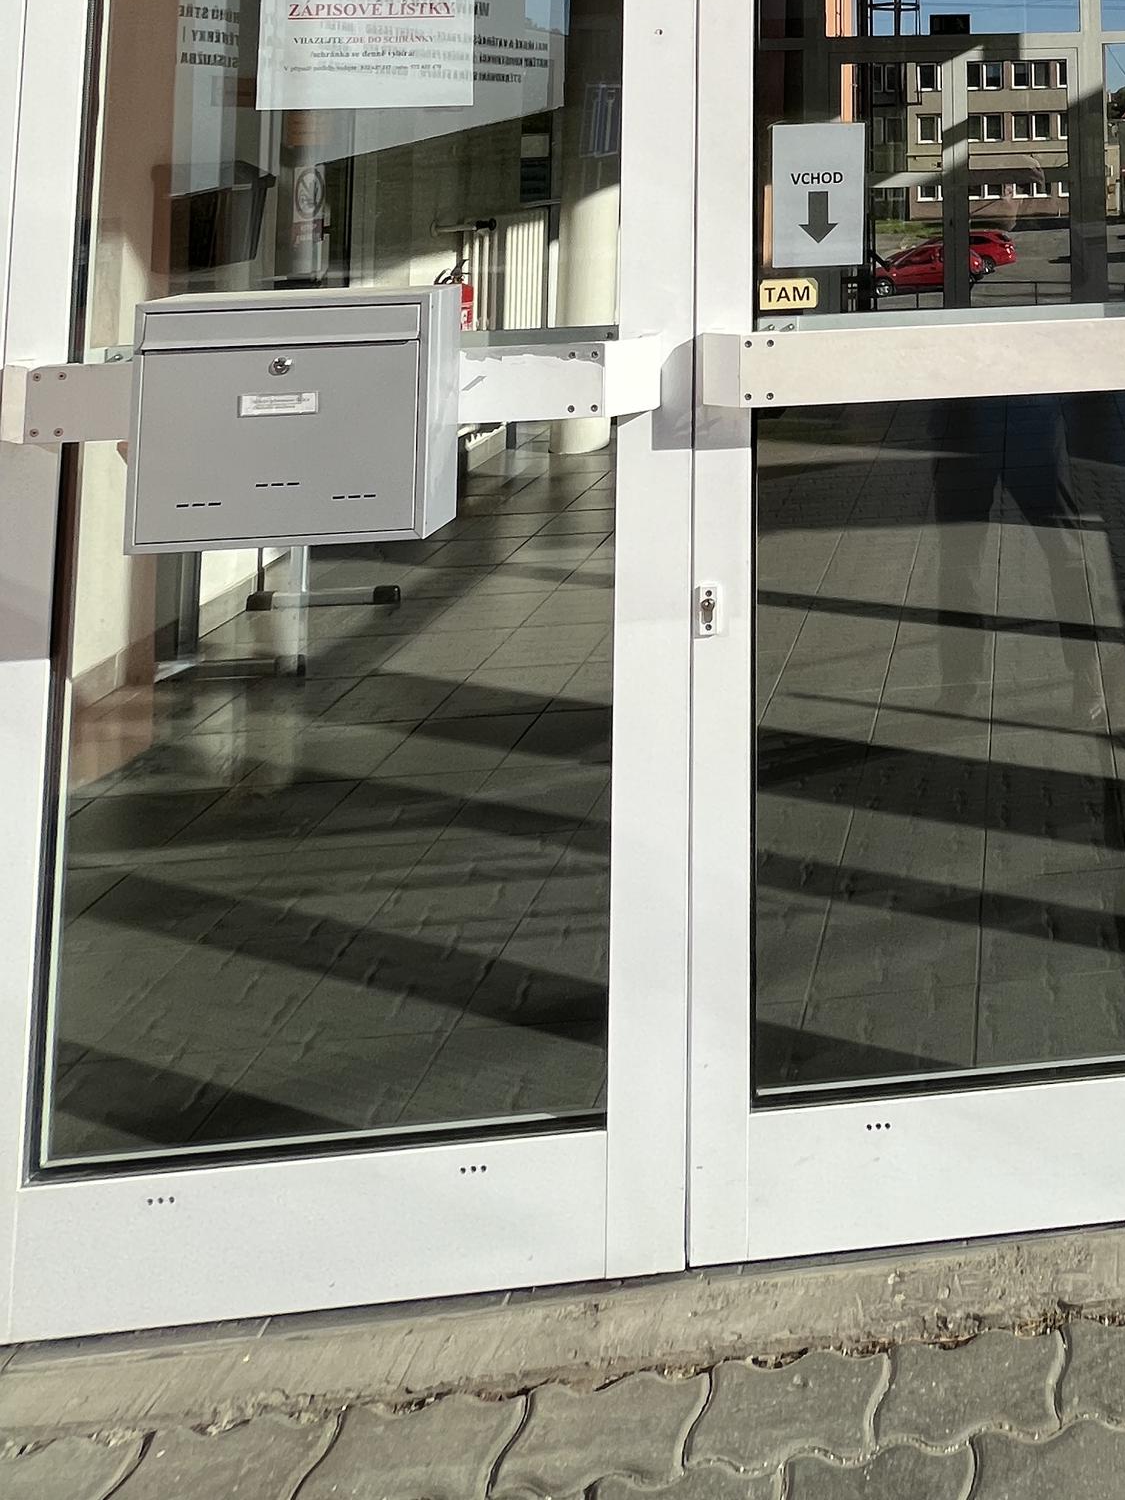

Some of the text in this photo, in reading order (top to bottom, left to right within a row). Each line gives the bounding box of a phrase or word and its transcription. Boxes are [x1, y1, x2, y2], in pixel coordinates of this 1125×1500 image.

[288, 0, 383, 17] ZÁPISOVÉ
[368, 36, 381, 44] DO
[790, 171, 844, 186] VCHOD
[764, 285, 811, 304] TAM
